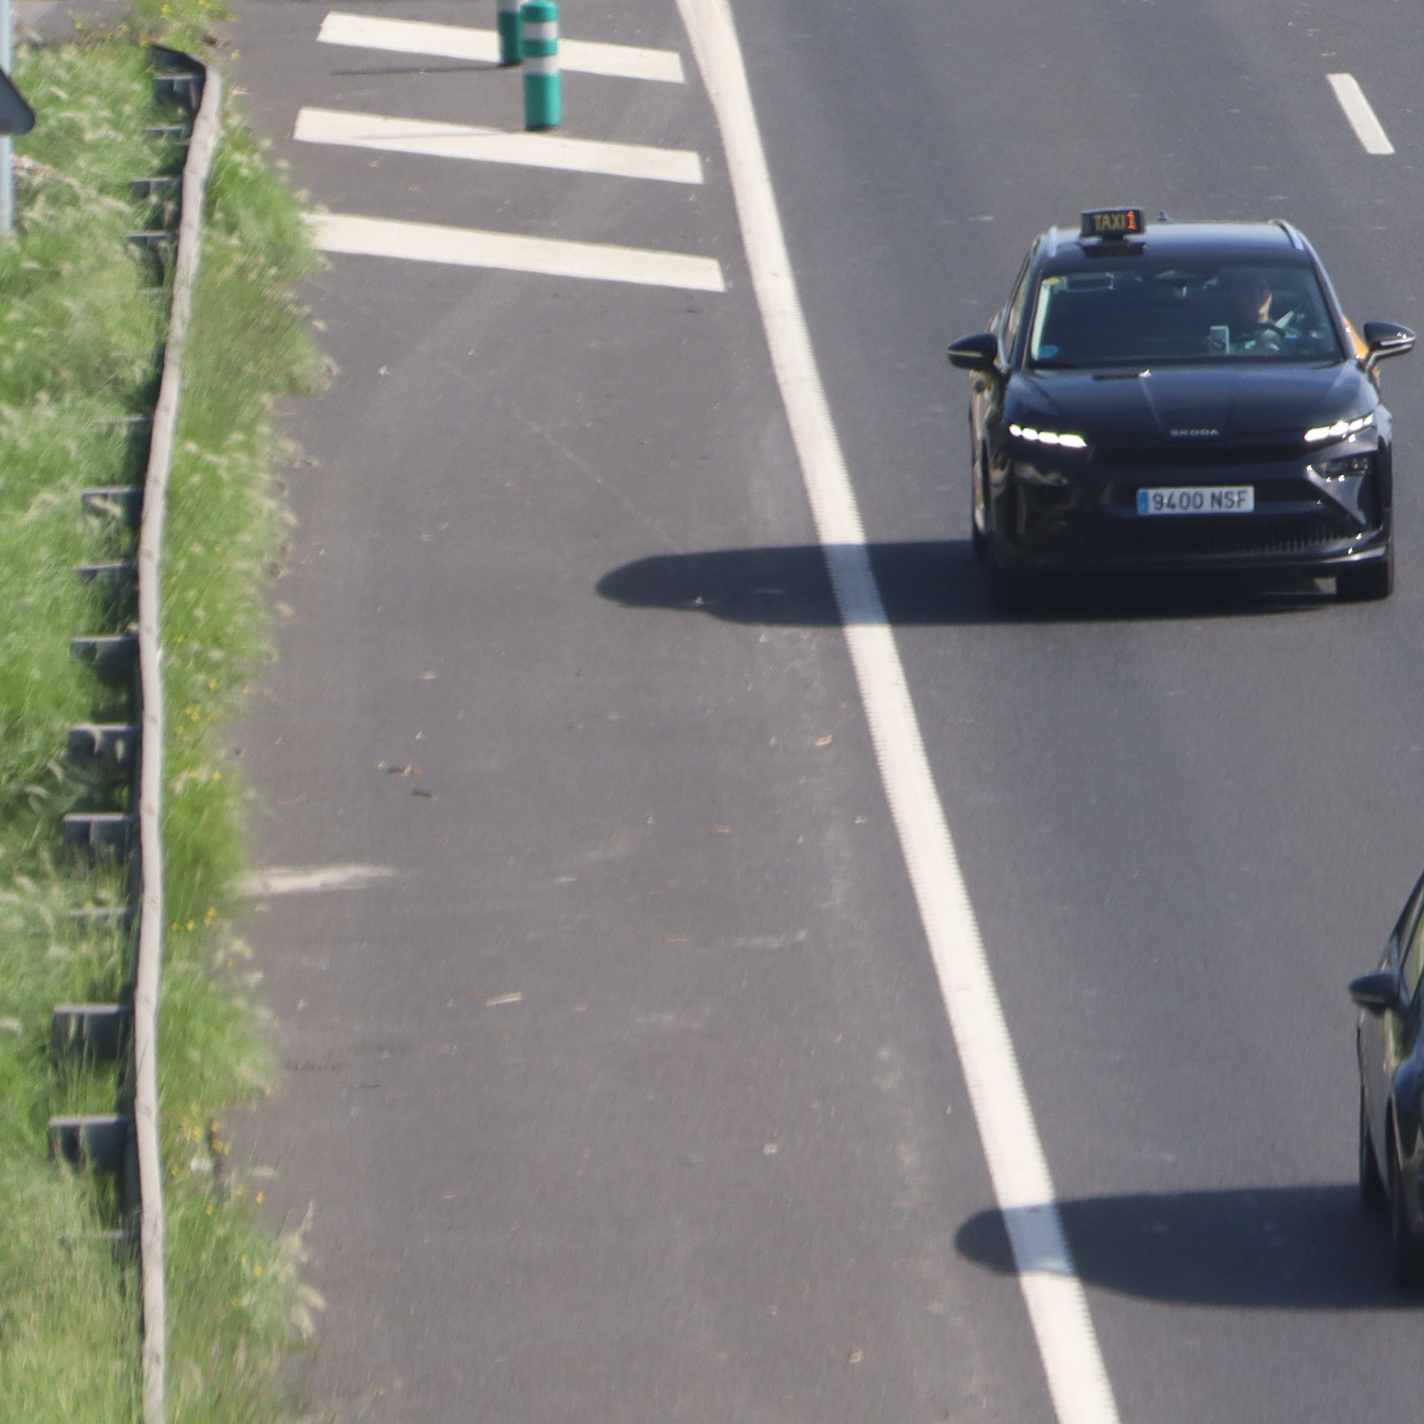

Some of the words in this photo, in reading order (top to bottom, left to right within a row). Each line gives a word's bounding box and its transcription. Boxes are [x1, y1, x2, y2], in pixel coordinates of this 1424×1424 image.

[1093, 212, 1126, 232] TAXI
[1152, 491, 1205, 511] 9400
[1210, 489, 1248, 509] NSF
